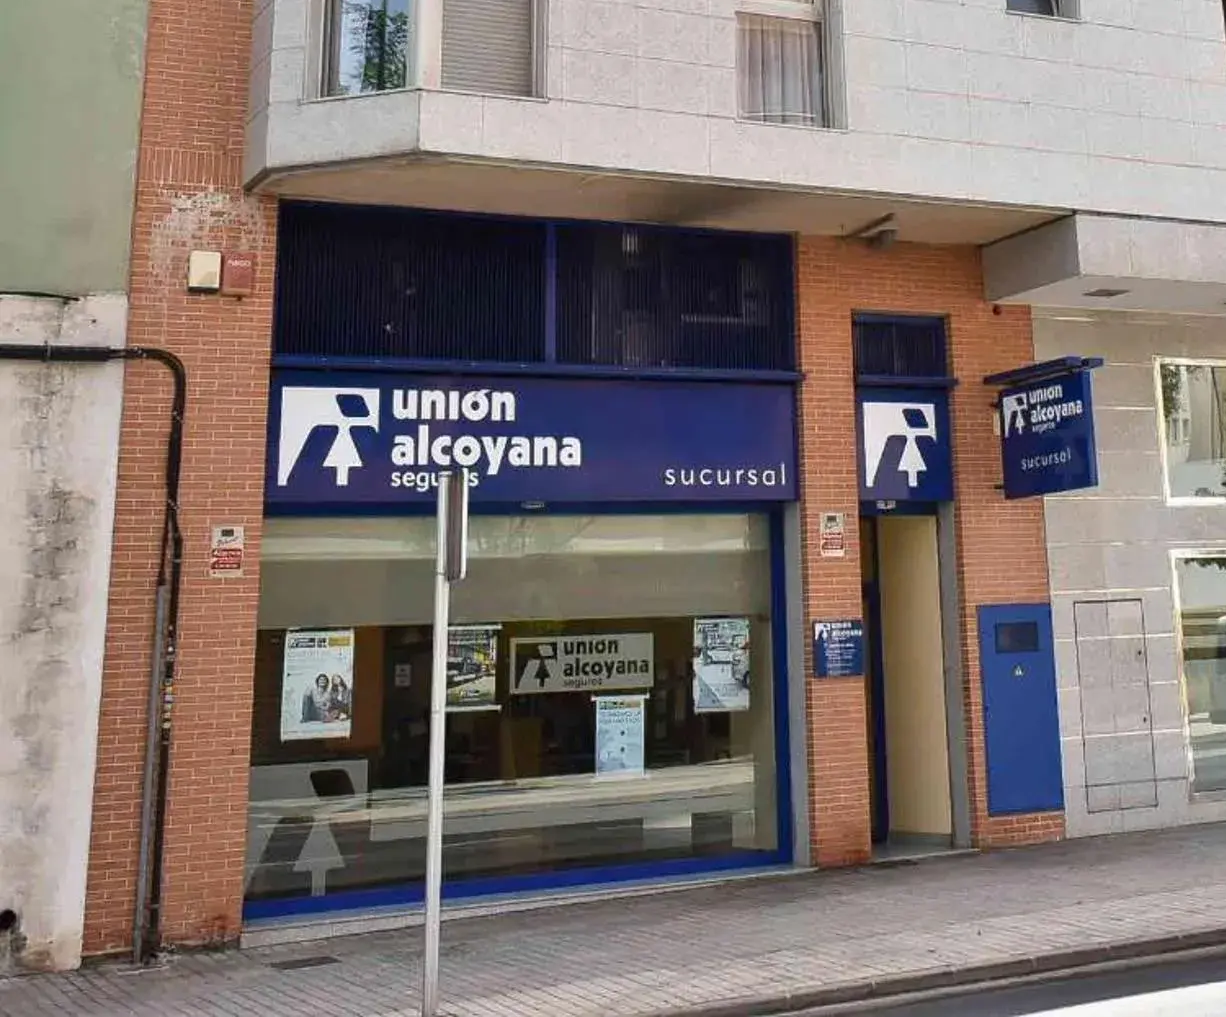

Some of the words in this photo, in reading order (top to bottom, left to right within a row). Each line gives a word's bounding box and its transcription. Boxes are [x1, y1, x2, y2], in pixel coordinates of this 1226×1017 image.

[1030, 400, 1084, 423] alcoyana
[390, 424, 583, 476] alcoyana
[1021, 447, 1072, 471] sucursal
[390, 471, 480, 492] segus
[664, 462, 786, 486] sucursal
[563, 658, 649, 679] alcoyana
